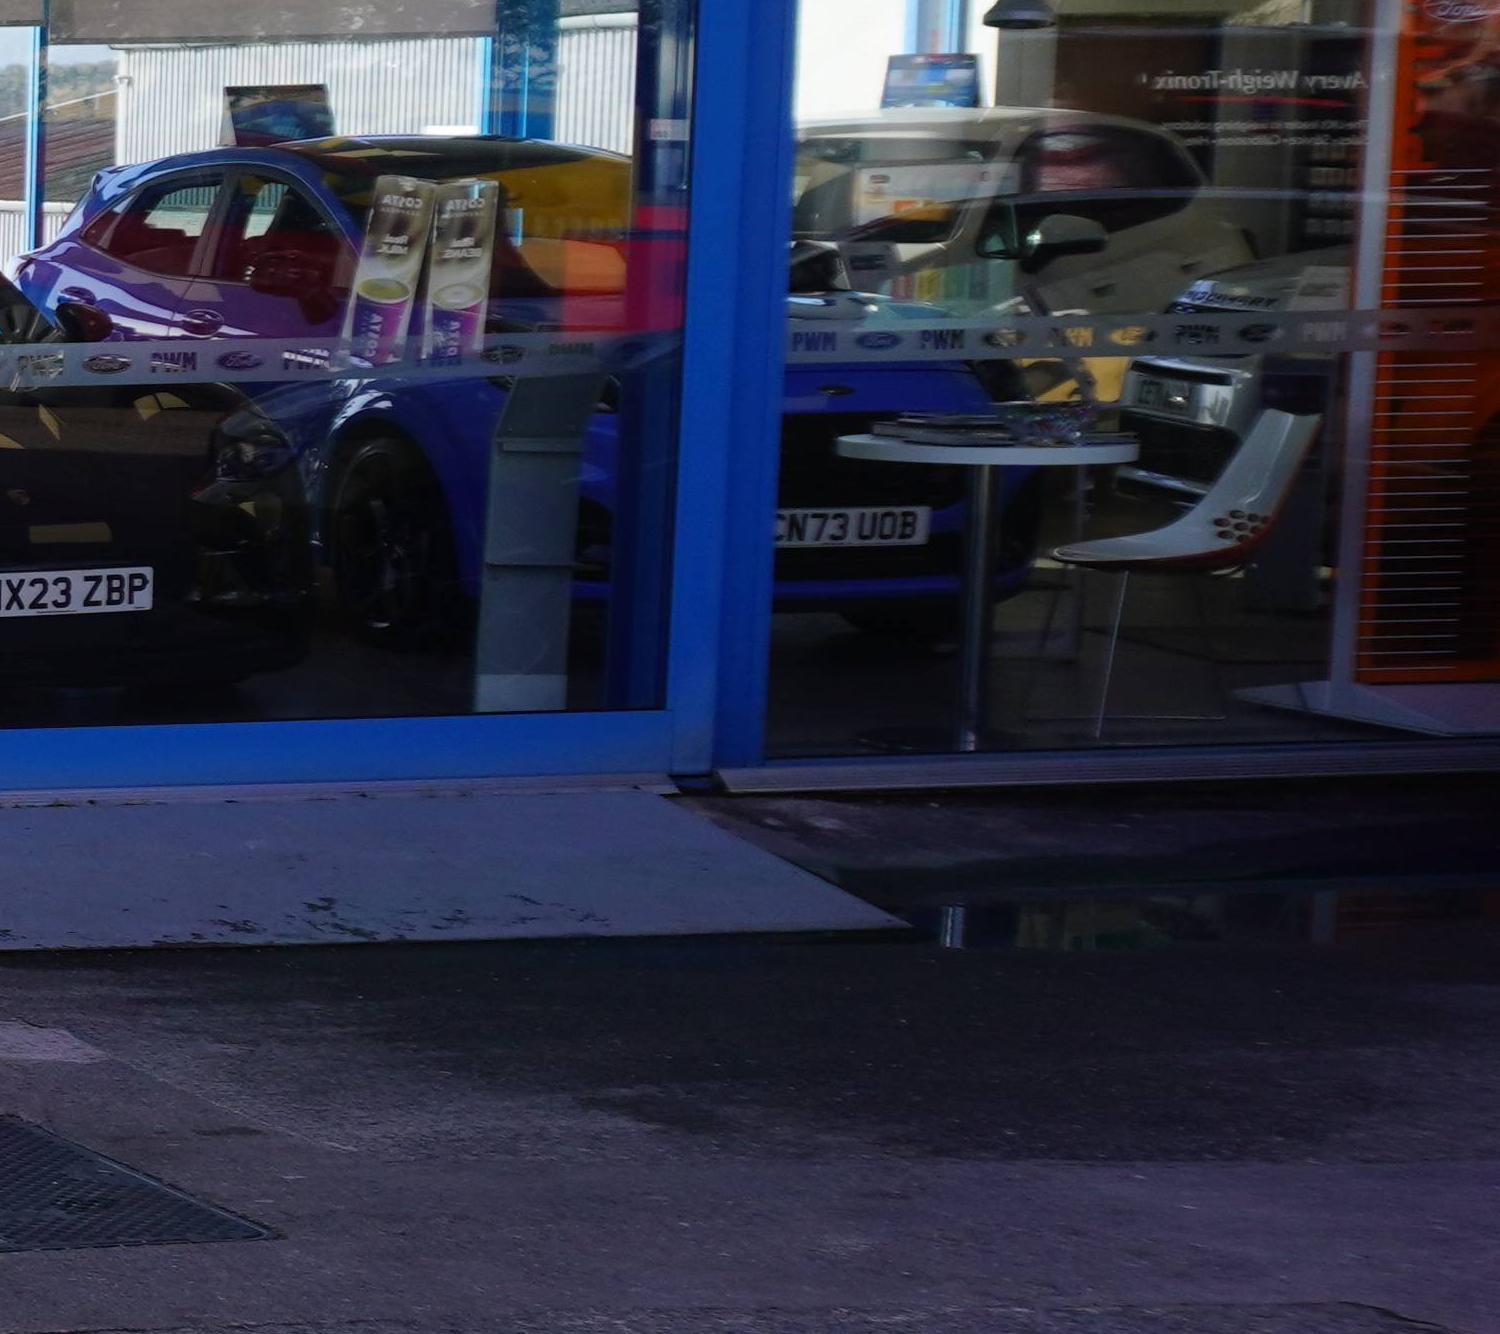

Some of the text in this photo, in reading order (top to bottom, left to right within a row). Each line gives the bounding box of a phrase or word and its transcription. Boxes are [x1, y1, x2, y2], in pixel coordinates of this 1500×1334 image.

[791, 329, 837, 351] PWM
[919, 328, 965, 350] PWM
[149, 351, 198, 373] PWM
[858, 511, 916, 540] UOB
[83, 573, 146, 607] ZBP
